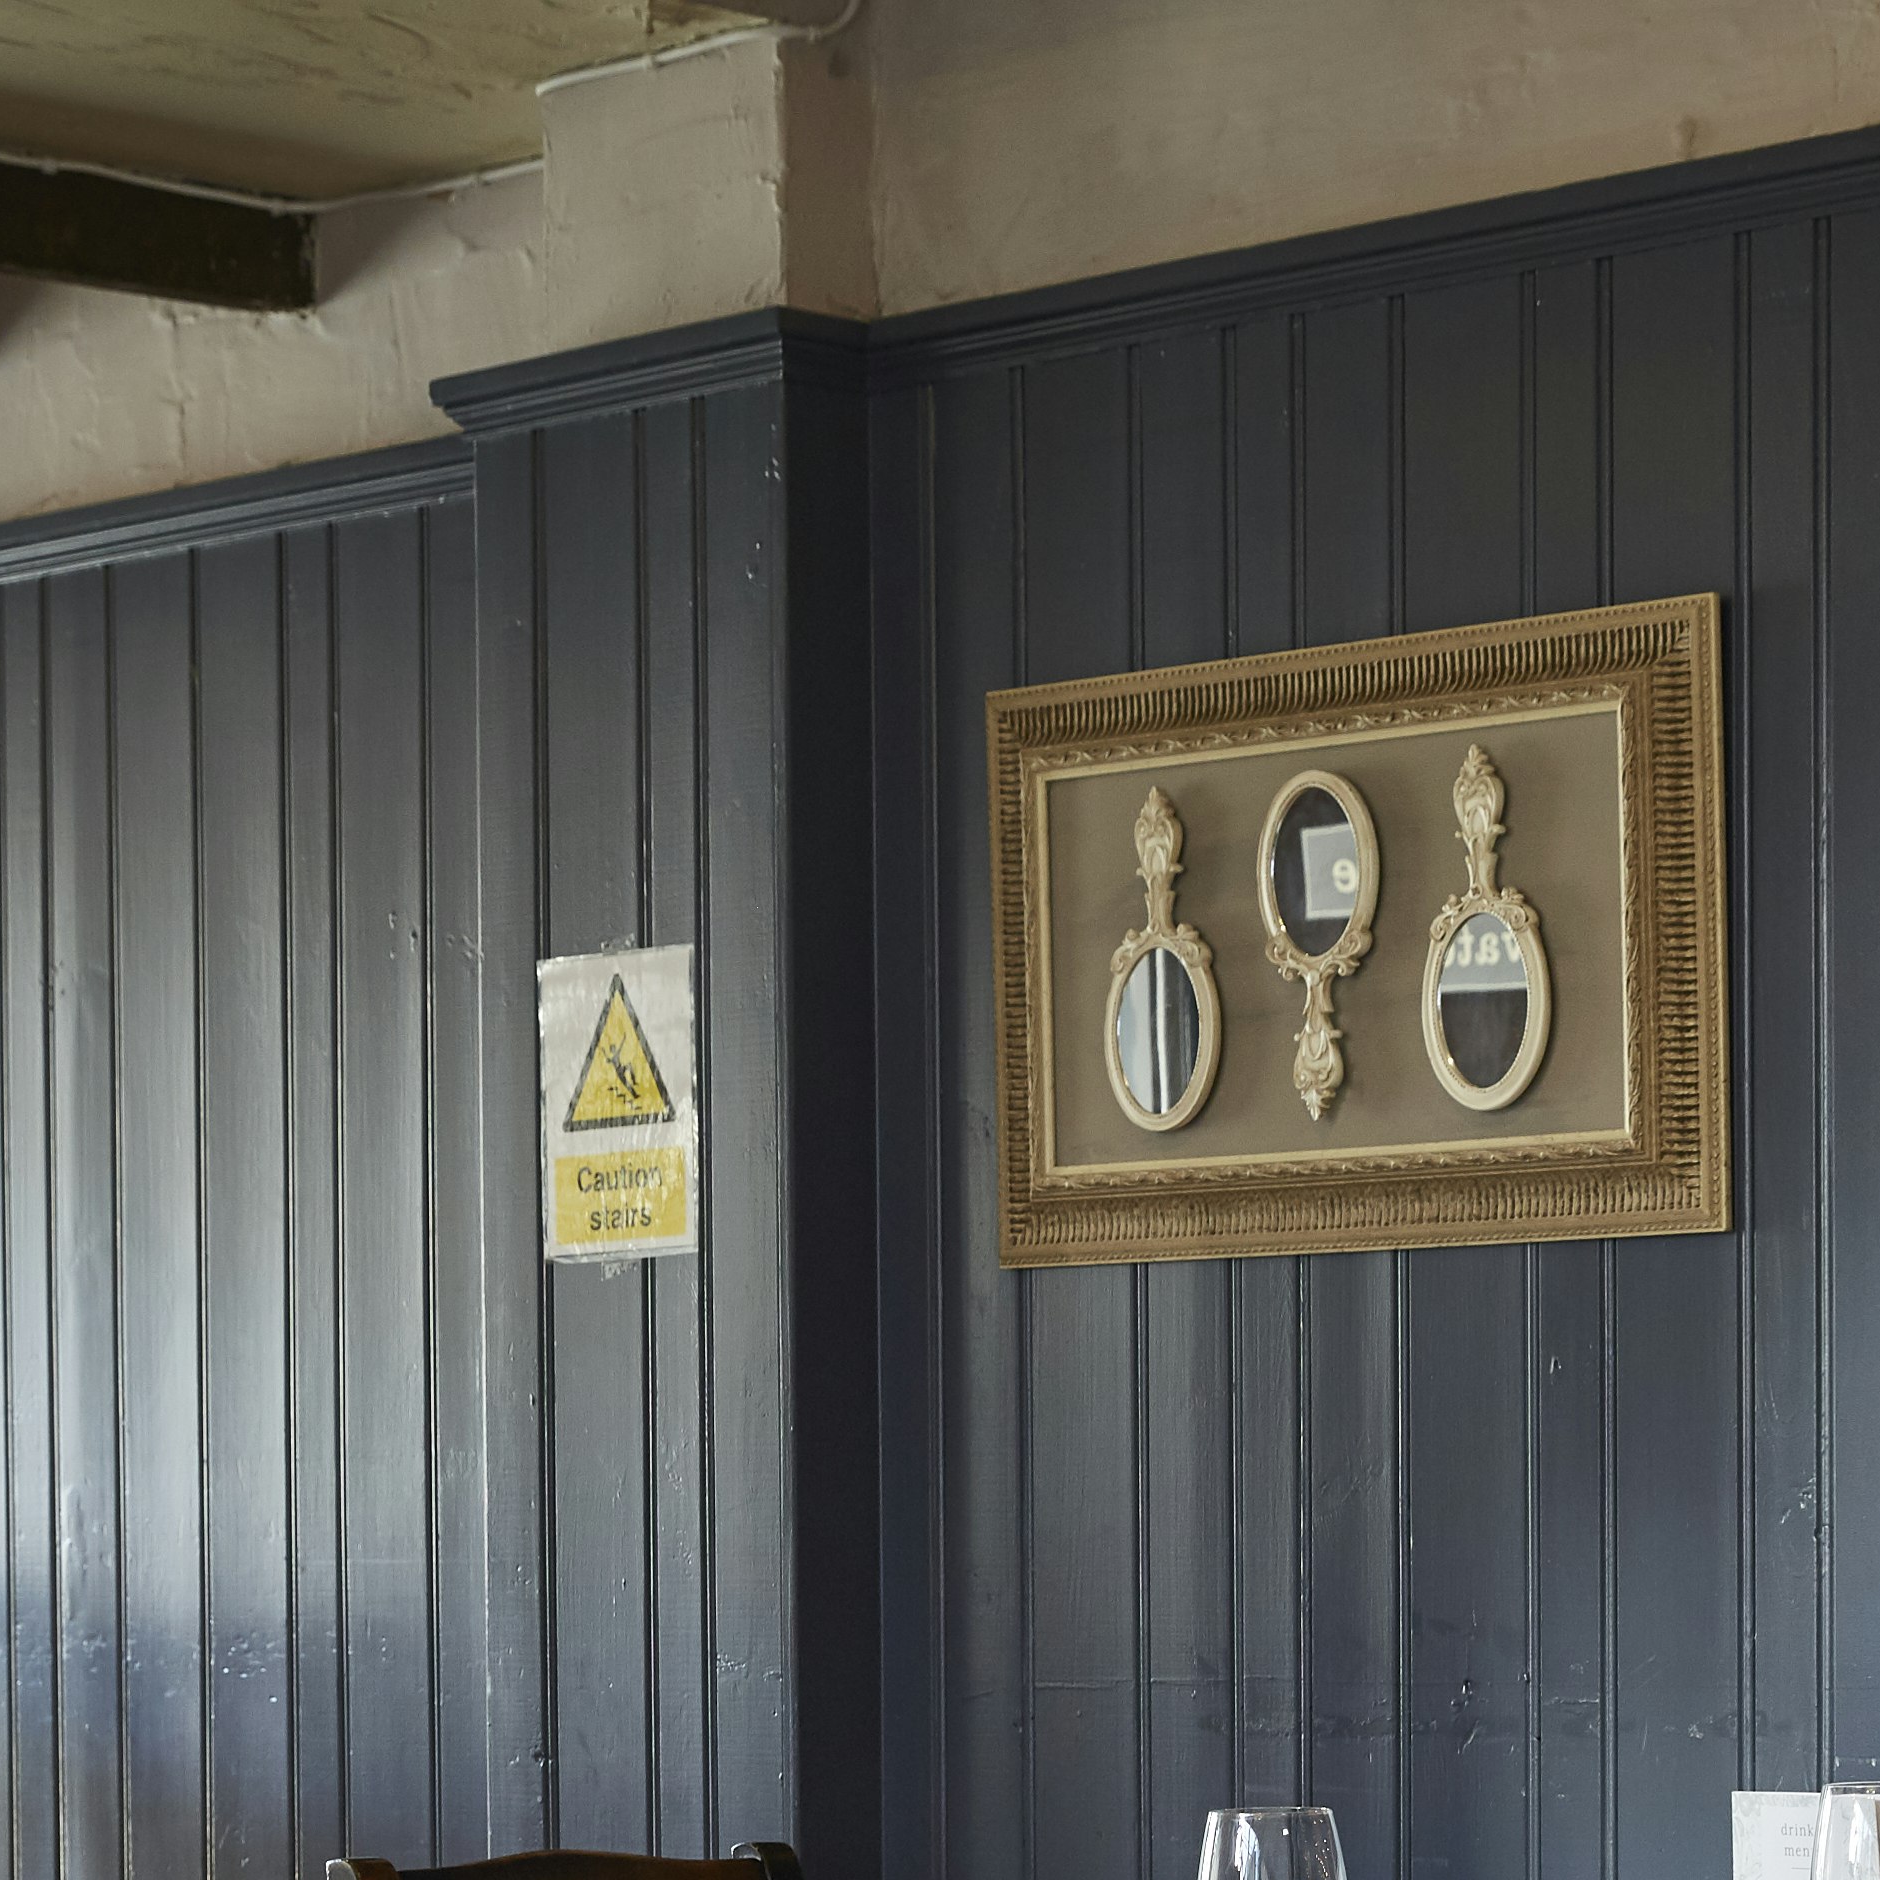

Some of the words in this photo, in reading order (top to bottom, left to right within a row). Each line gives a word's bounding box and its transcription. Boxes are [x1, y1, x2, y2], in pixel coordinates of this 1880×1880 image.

[577, 1162, 663, 1194] Caution
[590, 1202, 652, 1231] stairs
[1780, 1823, 1814, 1837] drink
[1784, 1846, 1813, 1857] men
